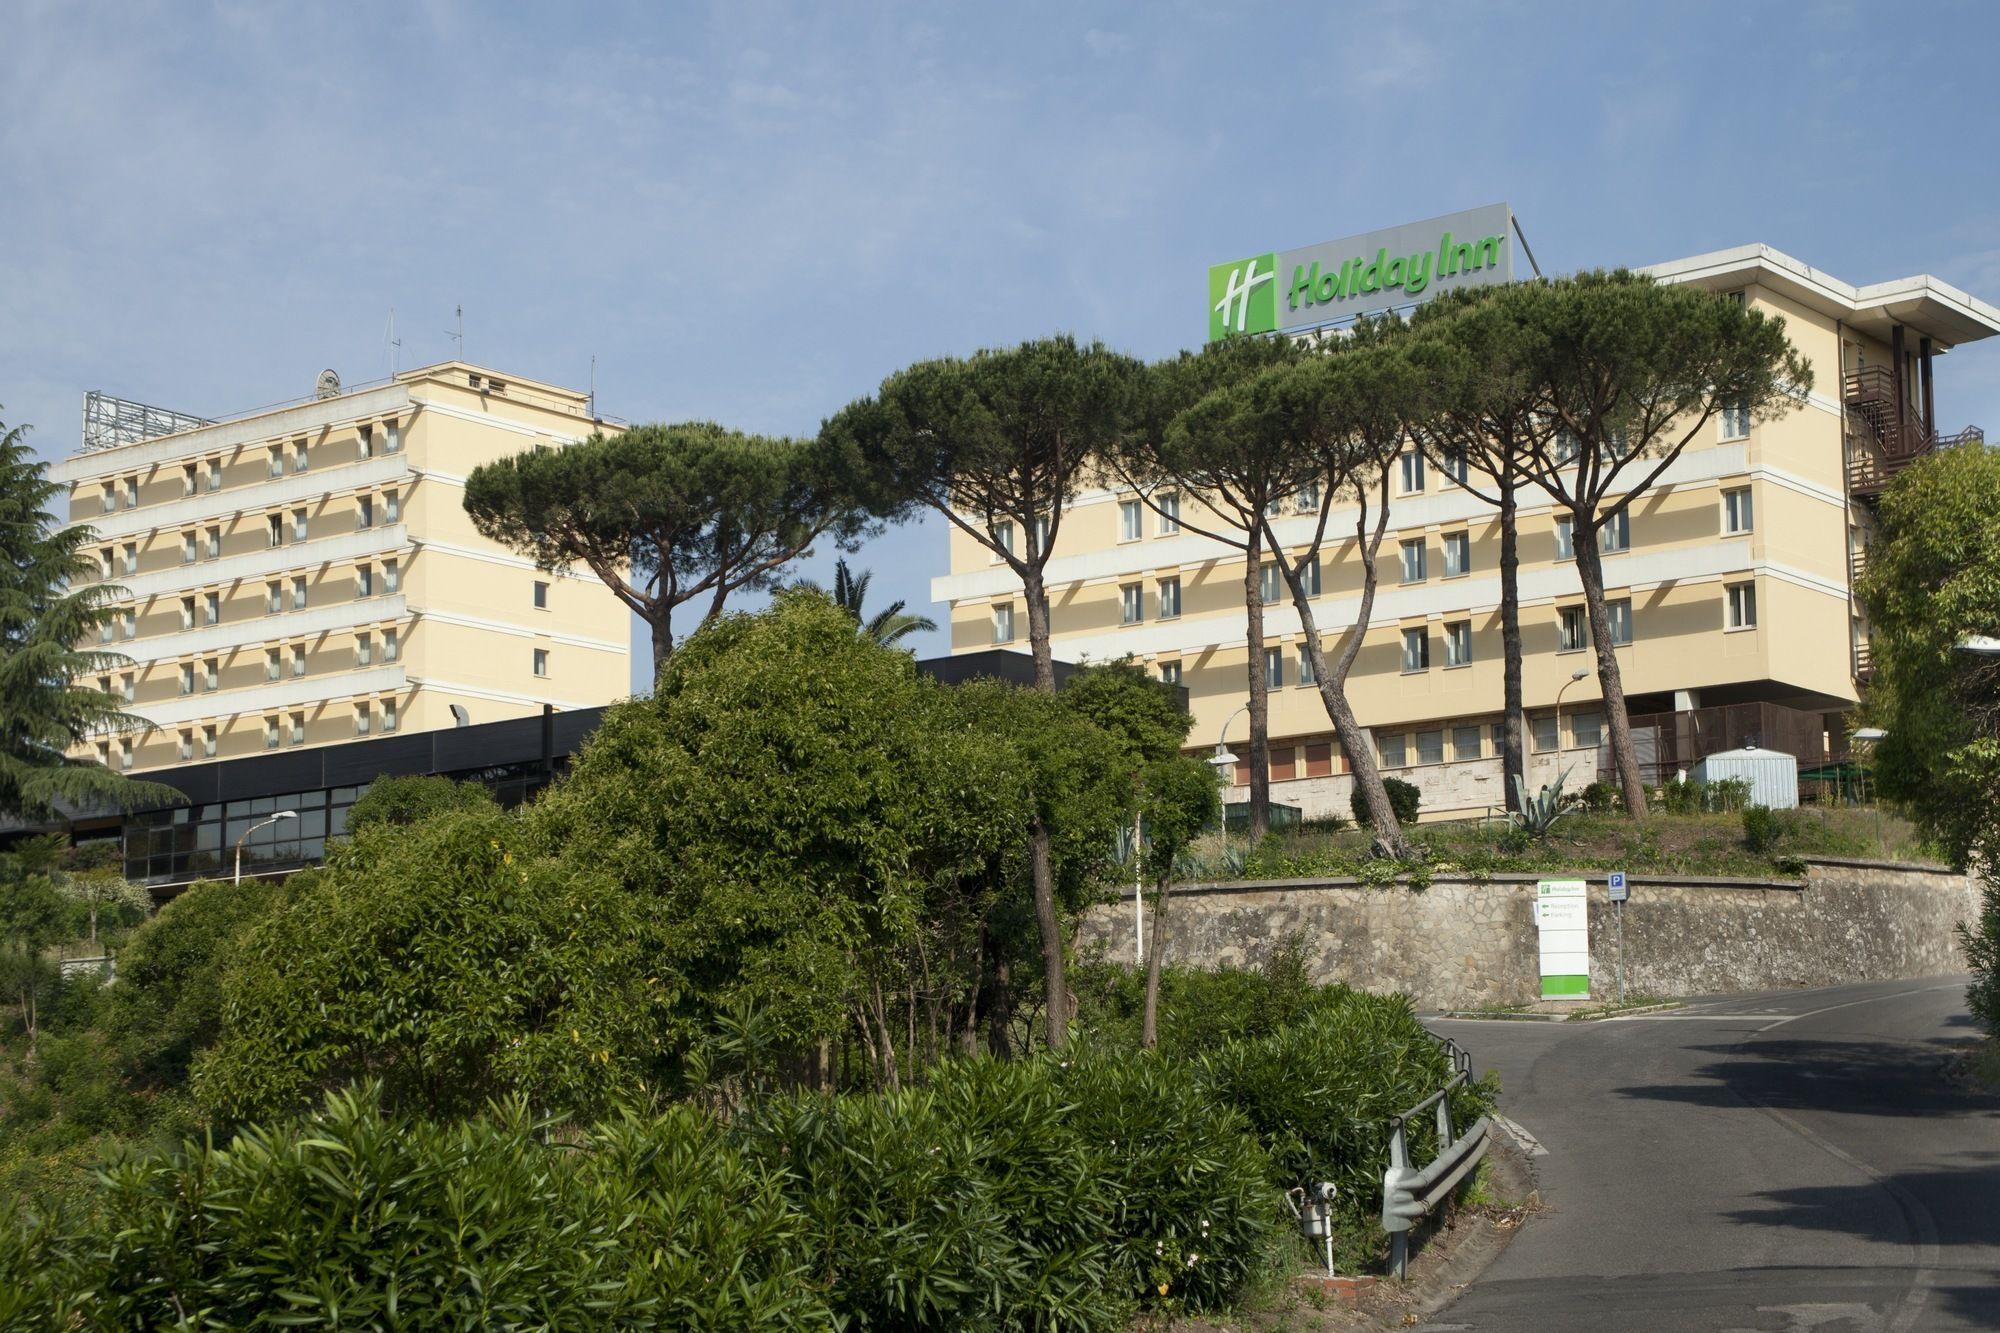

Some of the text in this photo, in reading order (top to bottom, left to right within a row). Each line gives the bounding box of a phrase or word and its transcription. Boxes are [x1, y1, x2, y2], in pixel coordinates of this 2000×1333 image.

[1289, 232, 1498, 308] Holiday Inn
[1613, 876, 1621, 886] P
